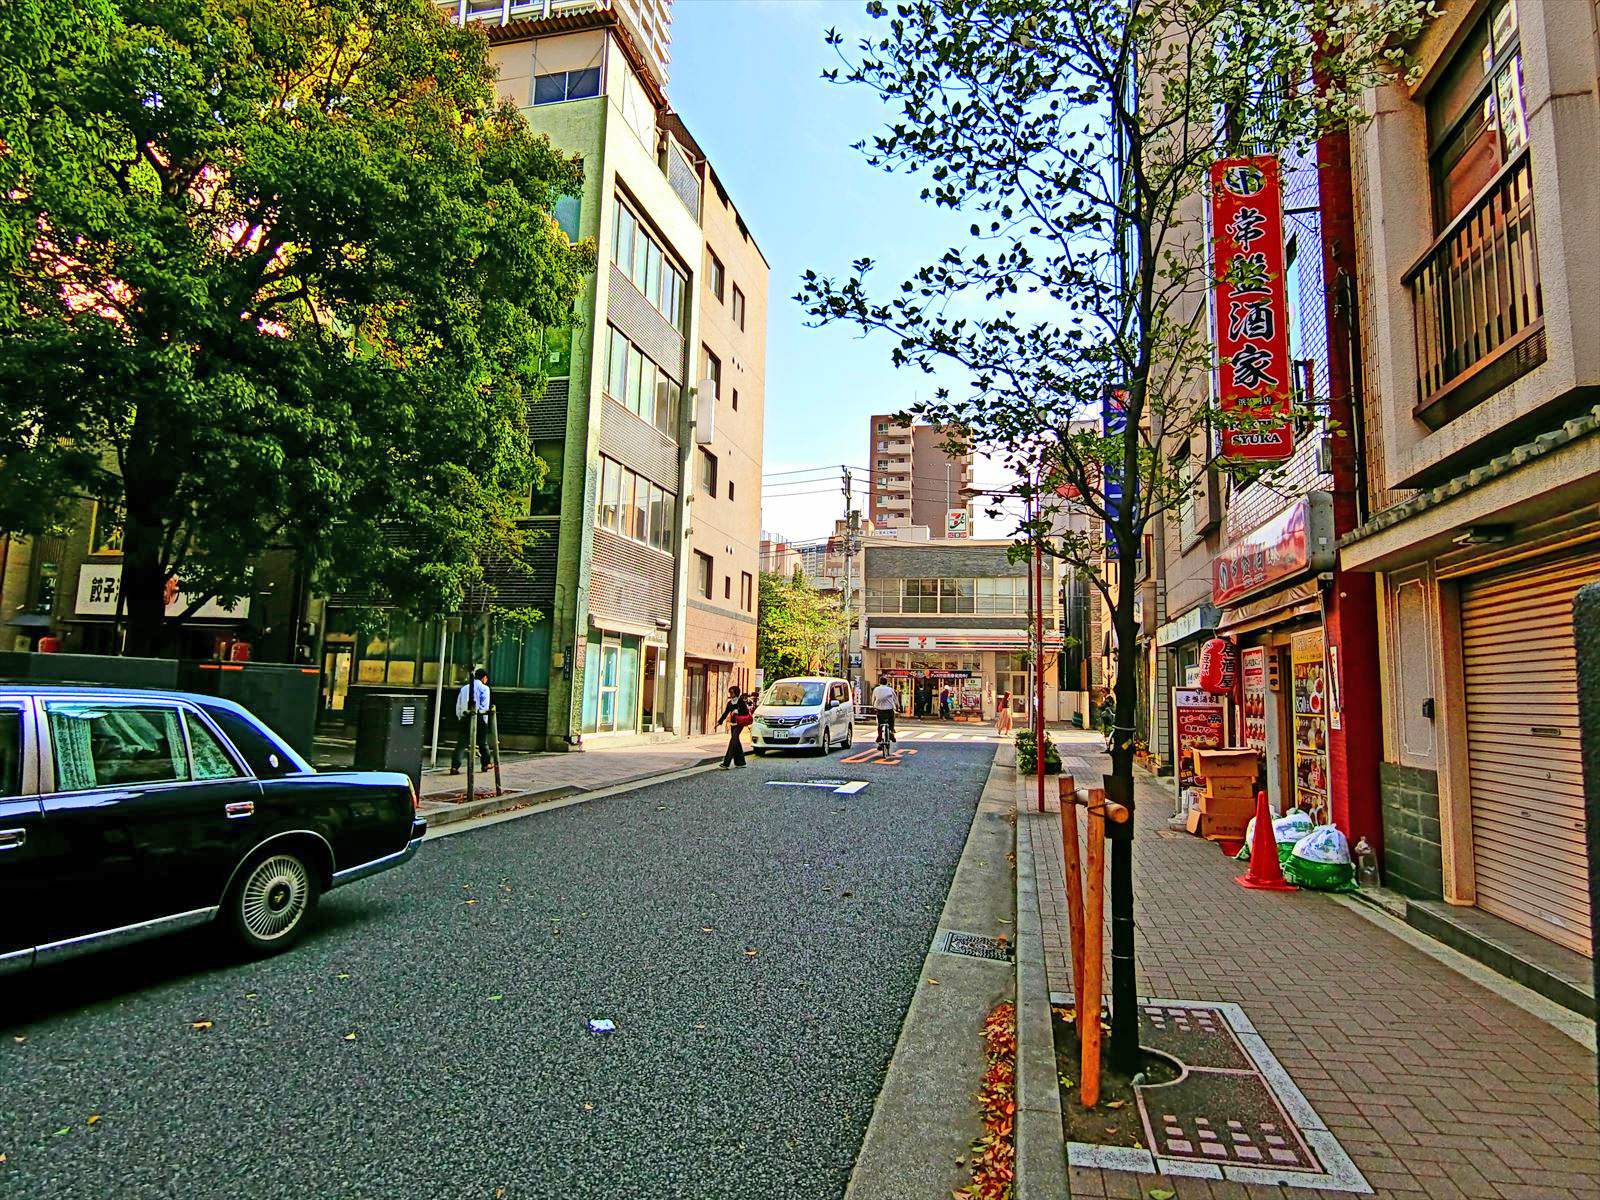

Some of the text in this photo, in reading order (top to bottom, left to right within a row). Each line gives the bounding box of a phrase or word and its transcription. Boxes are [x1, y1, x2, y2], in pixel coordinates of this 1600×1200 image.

[1226, 206, 1279, 391] 常盤酒家
[1231, 432, 1283, 446] SYUKA
